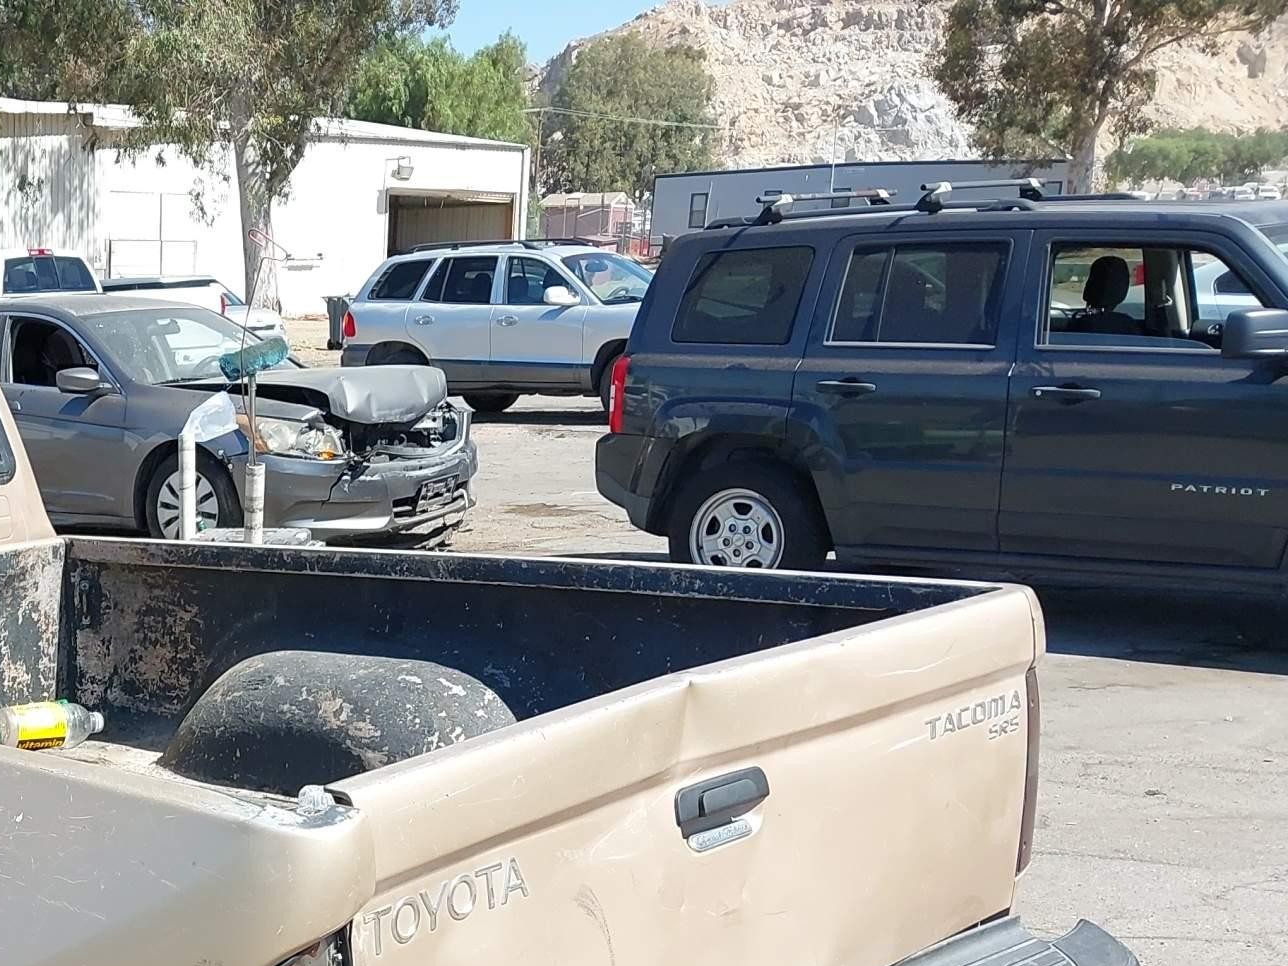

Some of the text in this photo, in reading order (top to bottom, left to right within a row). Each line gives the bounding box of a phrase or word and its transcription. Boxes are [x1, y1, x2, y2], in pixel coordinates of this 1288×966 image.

[1170, 483, 1270, 496] PATRIOT
[924, 689, 1022, 741] TACOMA
[987, 715, 1020, 741] SR5
[18, 738, 64, 750] vitamin
[363, 856, 530, 956] TOYOTA
